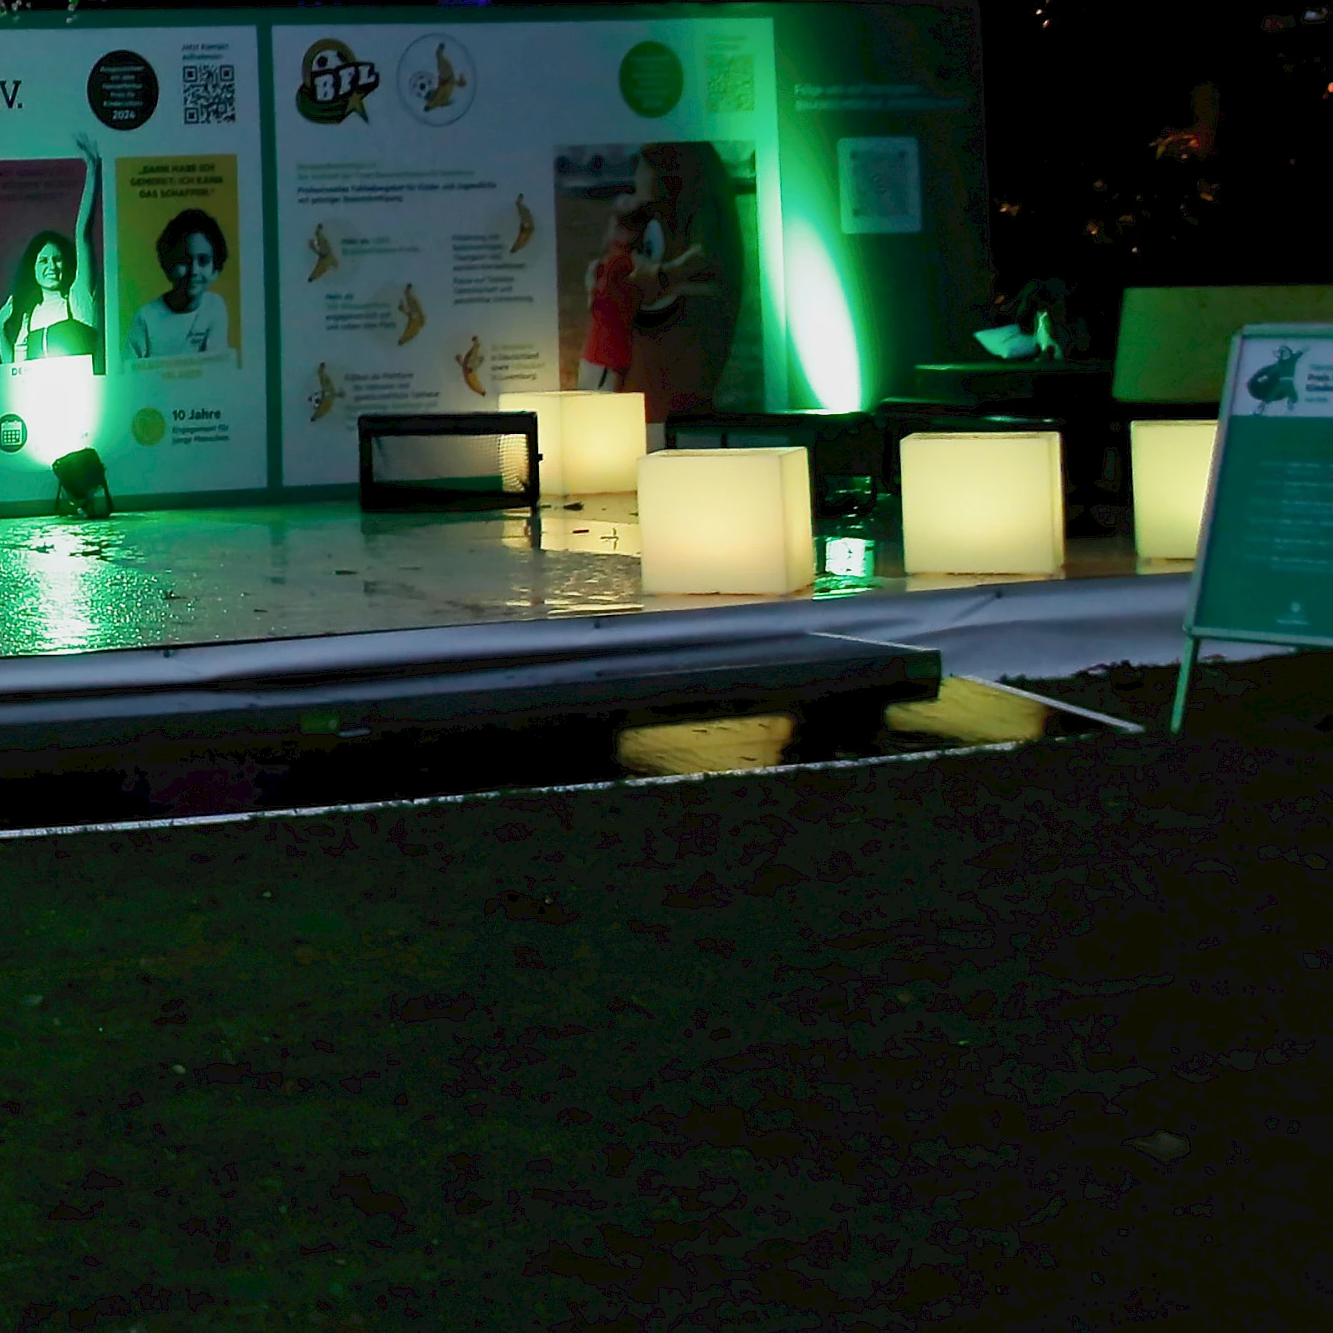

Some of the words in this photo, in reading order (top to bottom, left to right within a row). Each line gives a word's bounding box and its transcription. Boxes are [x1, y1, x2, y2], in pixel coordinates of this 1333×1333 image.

[110, 109, 136, 120] 2024
[172, 409, 186, 421] 10
[188, 408, 221, 420] Jahre
